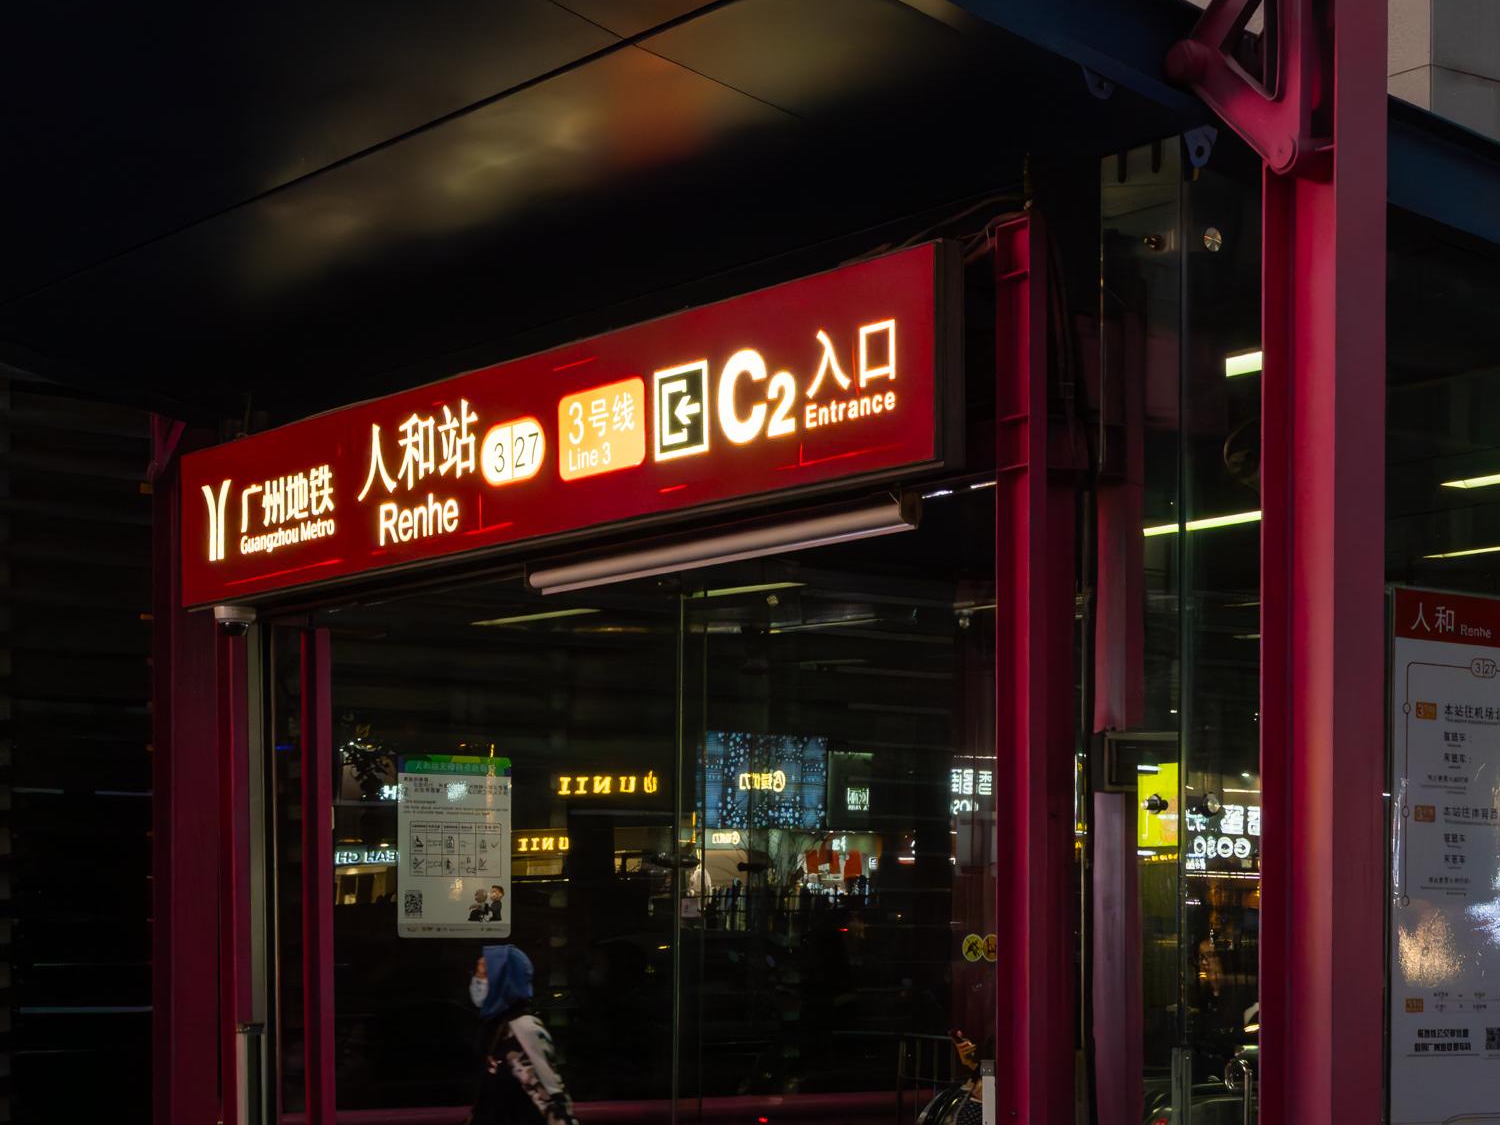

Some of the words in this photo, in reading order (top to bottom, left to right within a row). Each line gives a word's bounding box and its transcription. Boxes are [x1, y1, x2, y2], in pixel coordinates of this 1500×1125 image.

[806, 319, 896, 397] 入口
[568, 393, 636, 448] 3号线
[719, 349, 796, 444] C2
[805, 390, 896, 429] Entrance
[358, 399, 479, 503] 人和站
[493, 443, 506, 472] 3
[514, 432, 541, 466] 27
[568, 448, 599, 473] Line
[602, 444, 612, 466] 3
[241, 466, 334, 533] 广州地铁
[379, 499, 459, 547] Renhe
[240, 527, 298, 557] Guangzhou
[300, 519, 335, 543] Metro
[1410, 602, 1456, 634] 人和
[1460, 624, 1493, 639] Renhe
